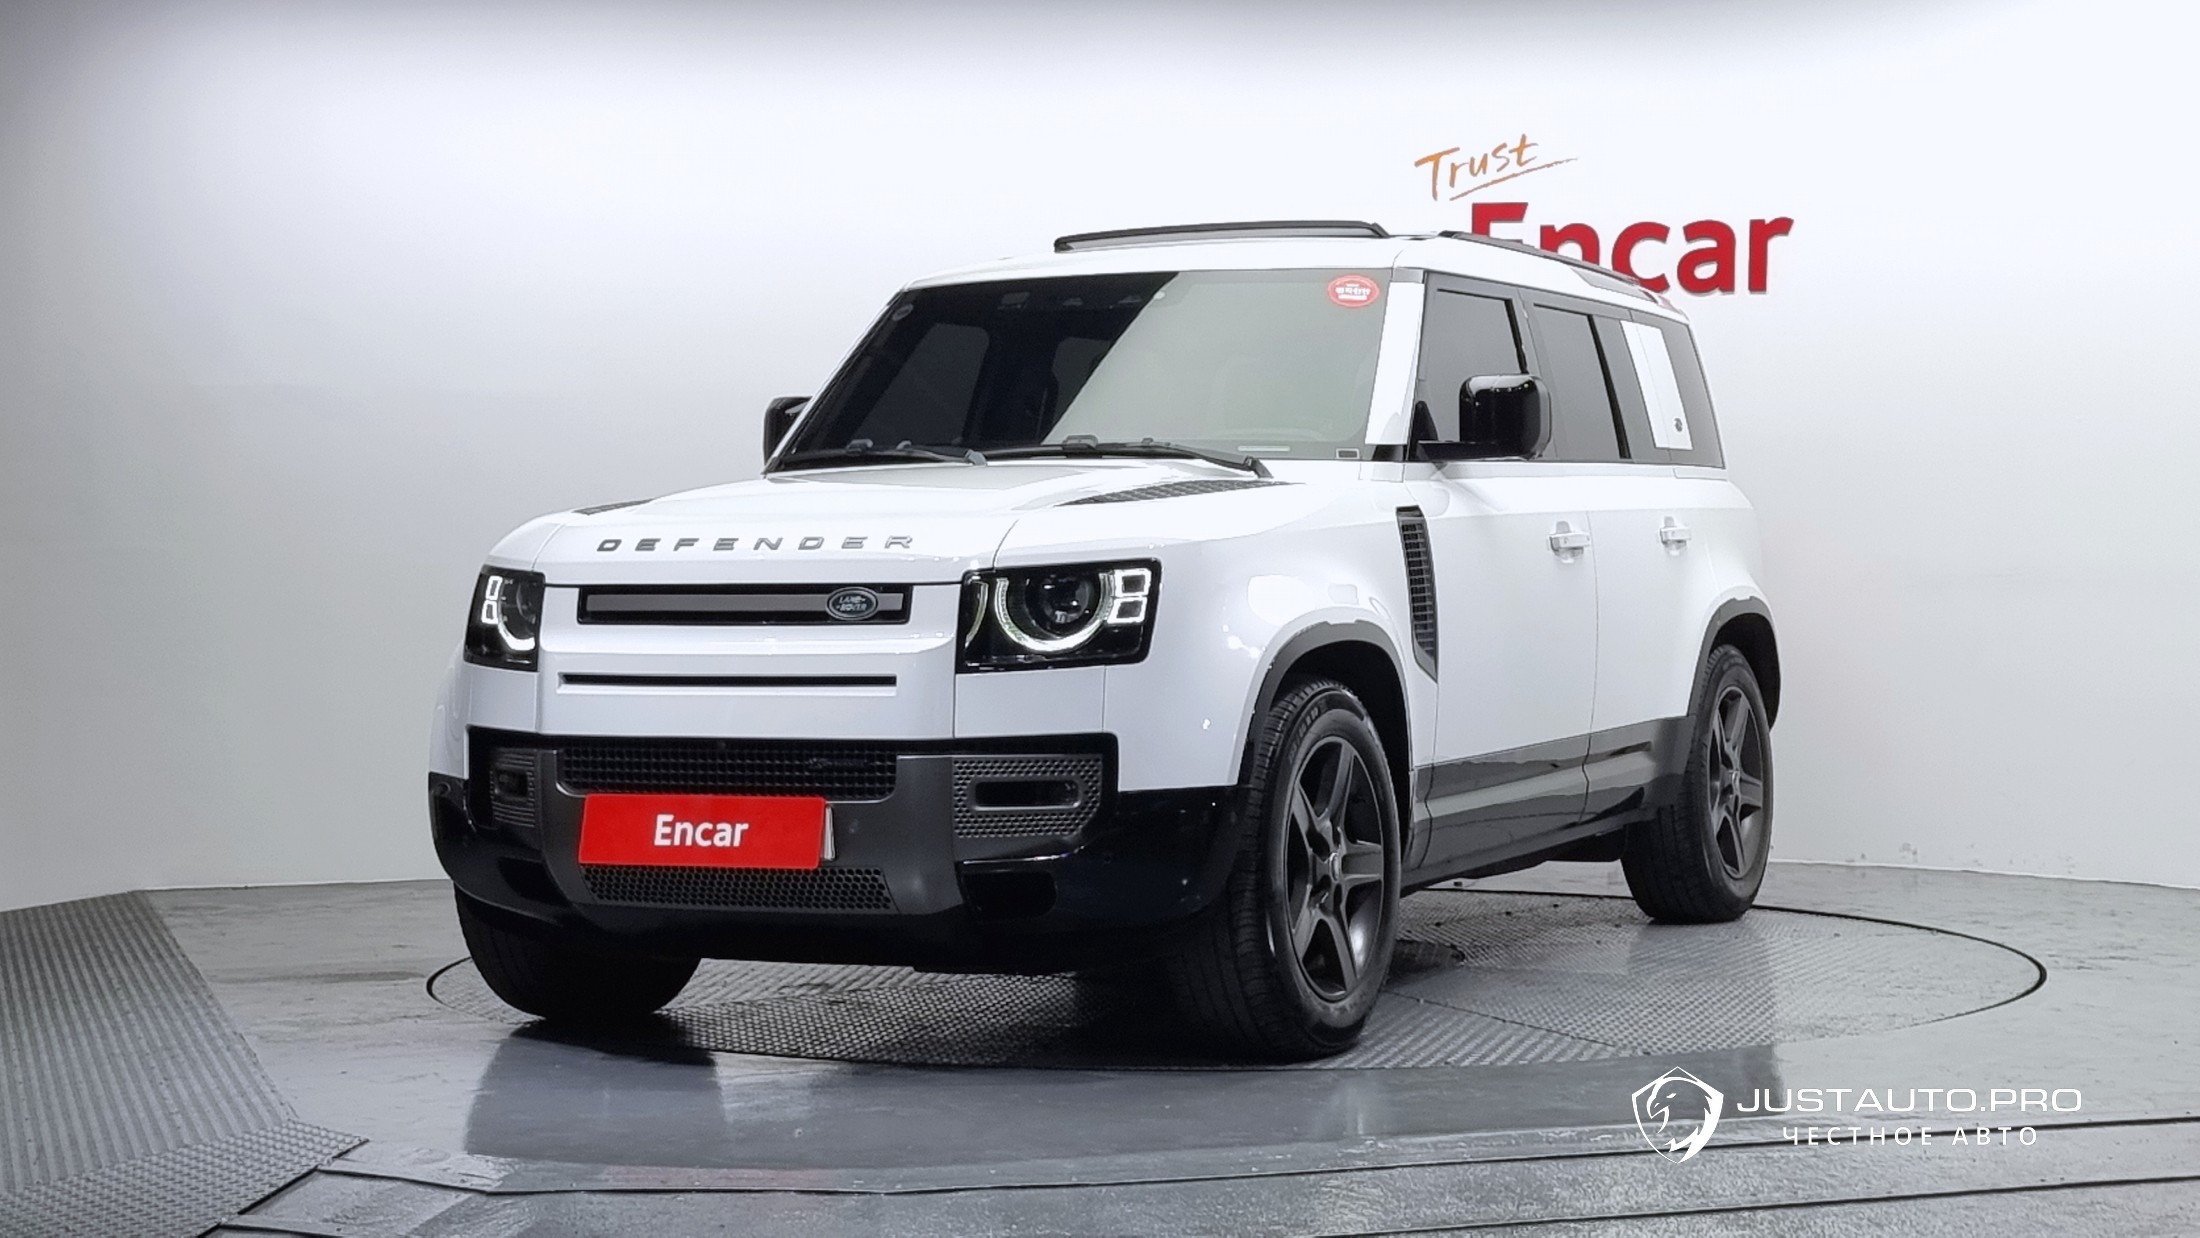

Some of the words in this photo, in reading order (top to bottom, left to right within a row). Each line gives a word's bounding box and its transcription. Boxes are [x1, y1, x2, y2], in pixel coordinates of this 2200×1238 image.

[1414, 133, 1539, 201] Trust
[596, 536, 912, 552] DEFENDER
[654, 814, 749, 847] Encar
